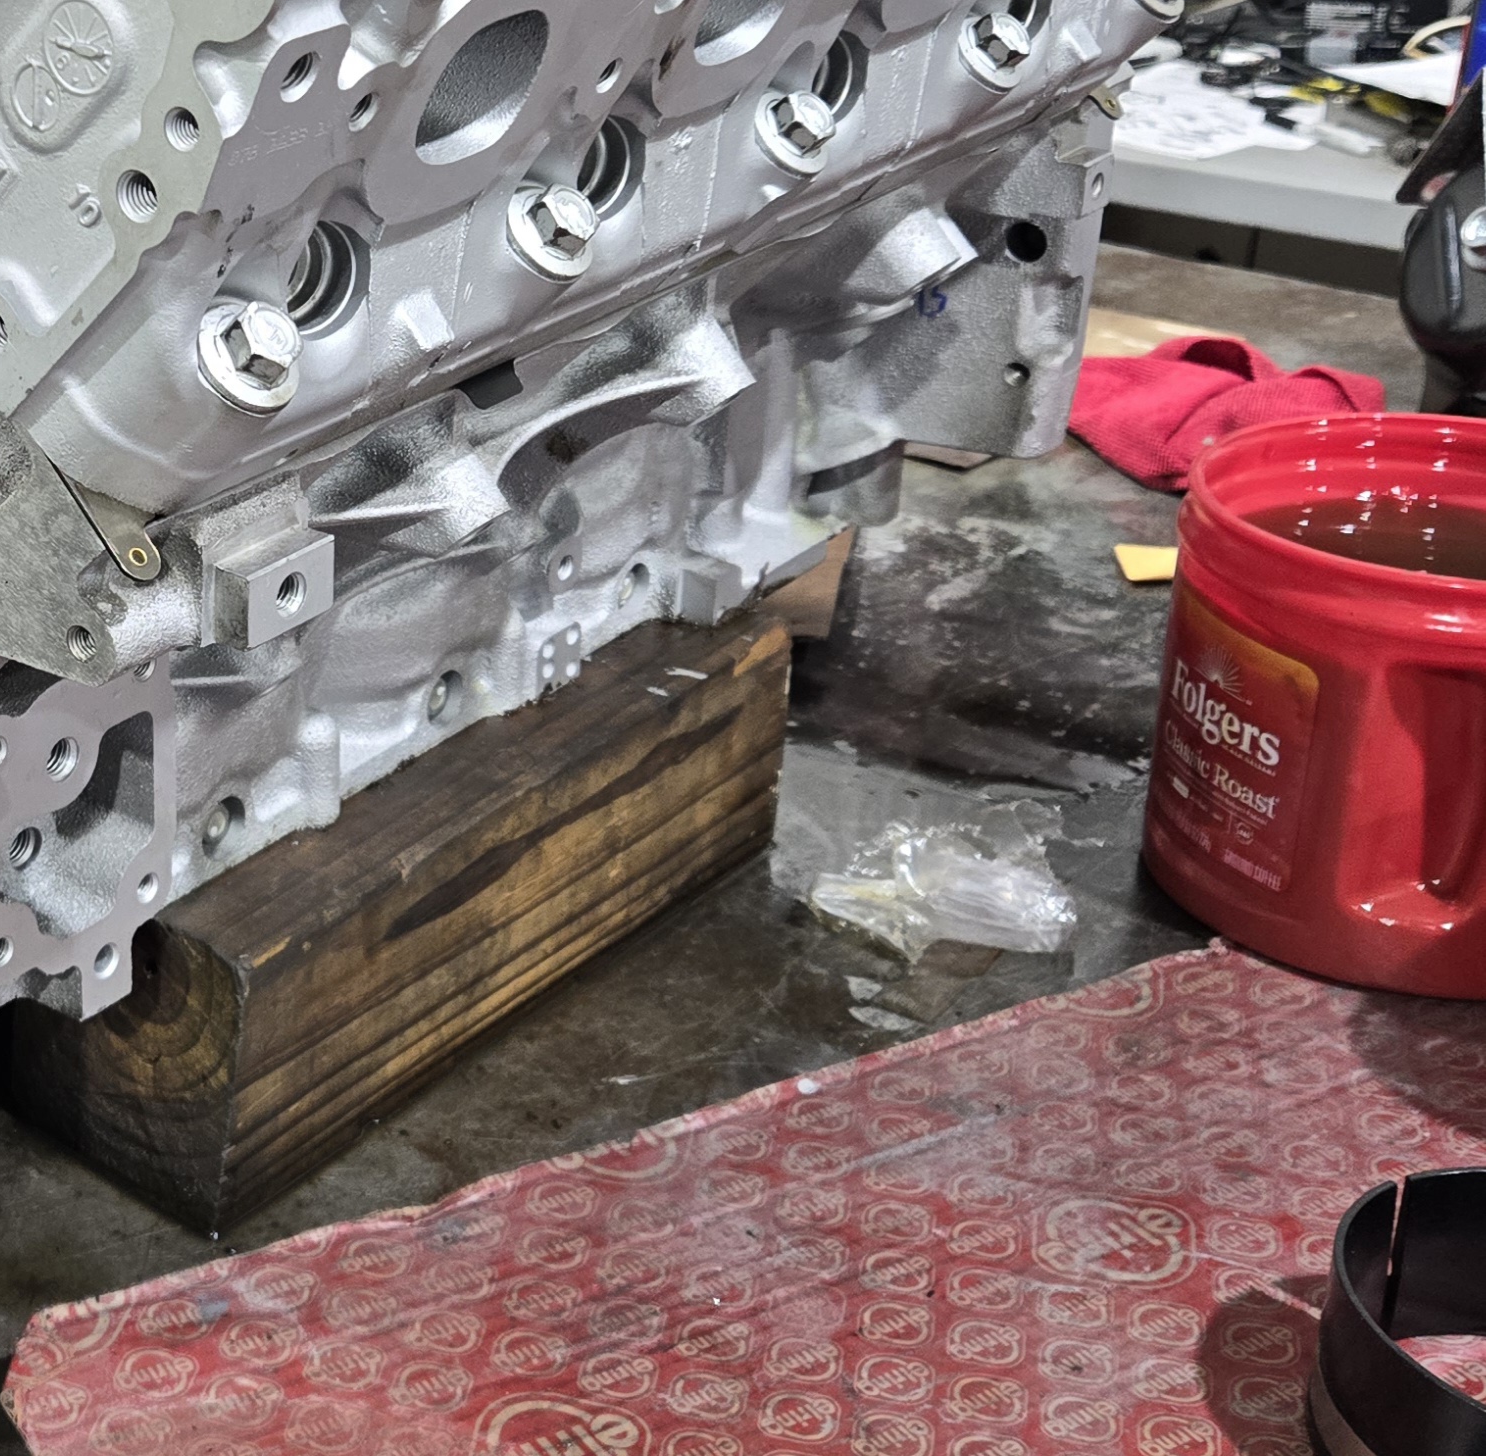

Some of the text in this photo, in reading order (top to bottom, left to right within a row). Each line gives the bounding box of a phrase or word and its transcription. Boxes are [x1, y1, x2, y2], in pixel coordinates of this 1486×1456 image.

[1170, 656, 1281, 767] Folgers
[1165, 718, 1212, 780] Classic
[1212, 761, 1282, 820] Roast
[947, 1223, 1016, 1254] elring
[948, 1273, 1017, 1306] elring
[677, 1321, 750, 1356] elring
[862, 1305, 931, 1340] elring
[1130, 1307, 1200, 1341] elring
[222, 1325, 299, 1357] elring
[947, 1325, 1021, 1360] elring
[1224, 1325, 1292, 1359] elring
[116, 1355, 195, 1391] elring
[580, 1356, 656, 1392] elring
[768, 1342, 839, 1376] elring
[389, 1370, 471, 1406] elring
[857, 1360, 931, 1395] elring
[1134, 1362, 1205, 1398] elring
[669, 1378, 745, 1413] elring
[948, 1380, 1023, 1416] elring
[1231, 1382, 1303, 1417] elring
[760, 1397, 837, 1435] elring
[1044, 1399, 1117, 1437] elring
[852, 1418, 929, 1456] elring
